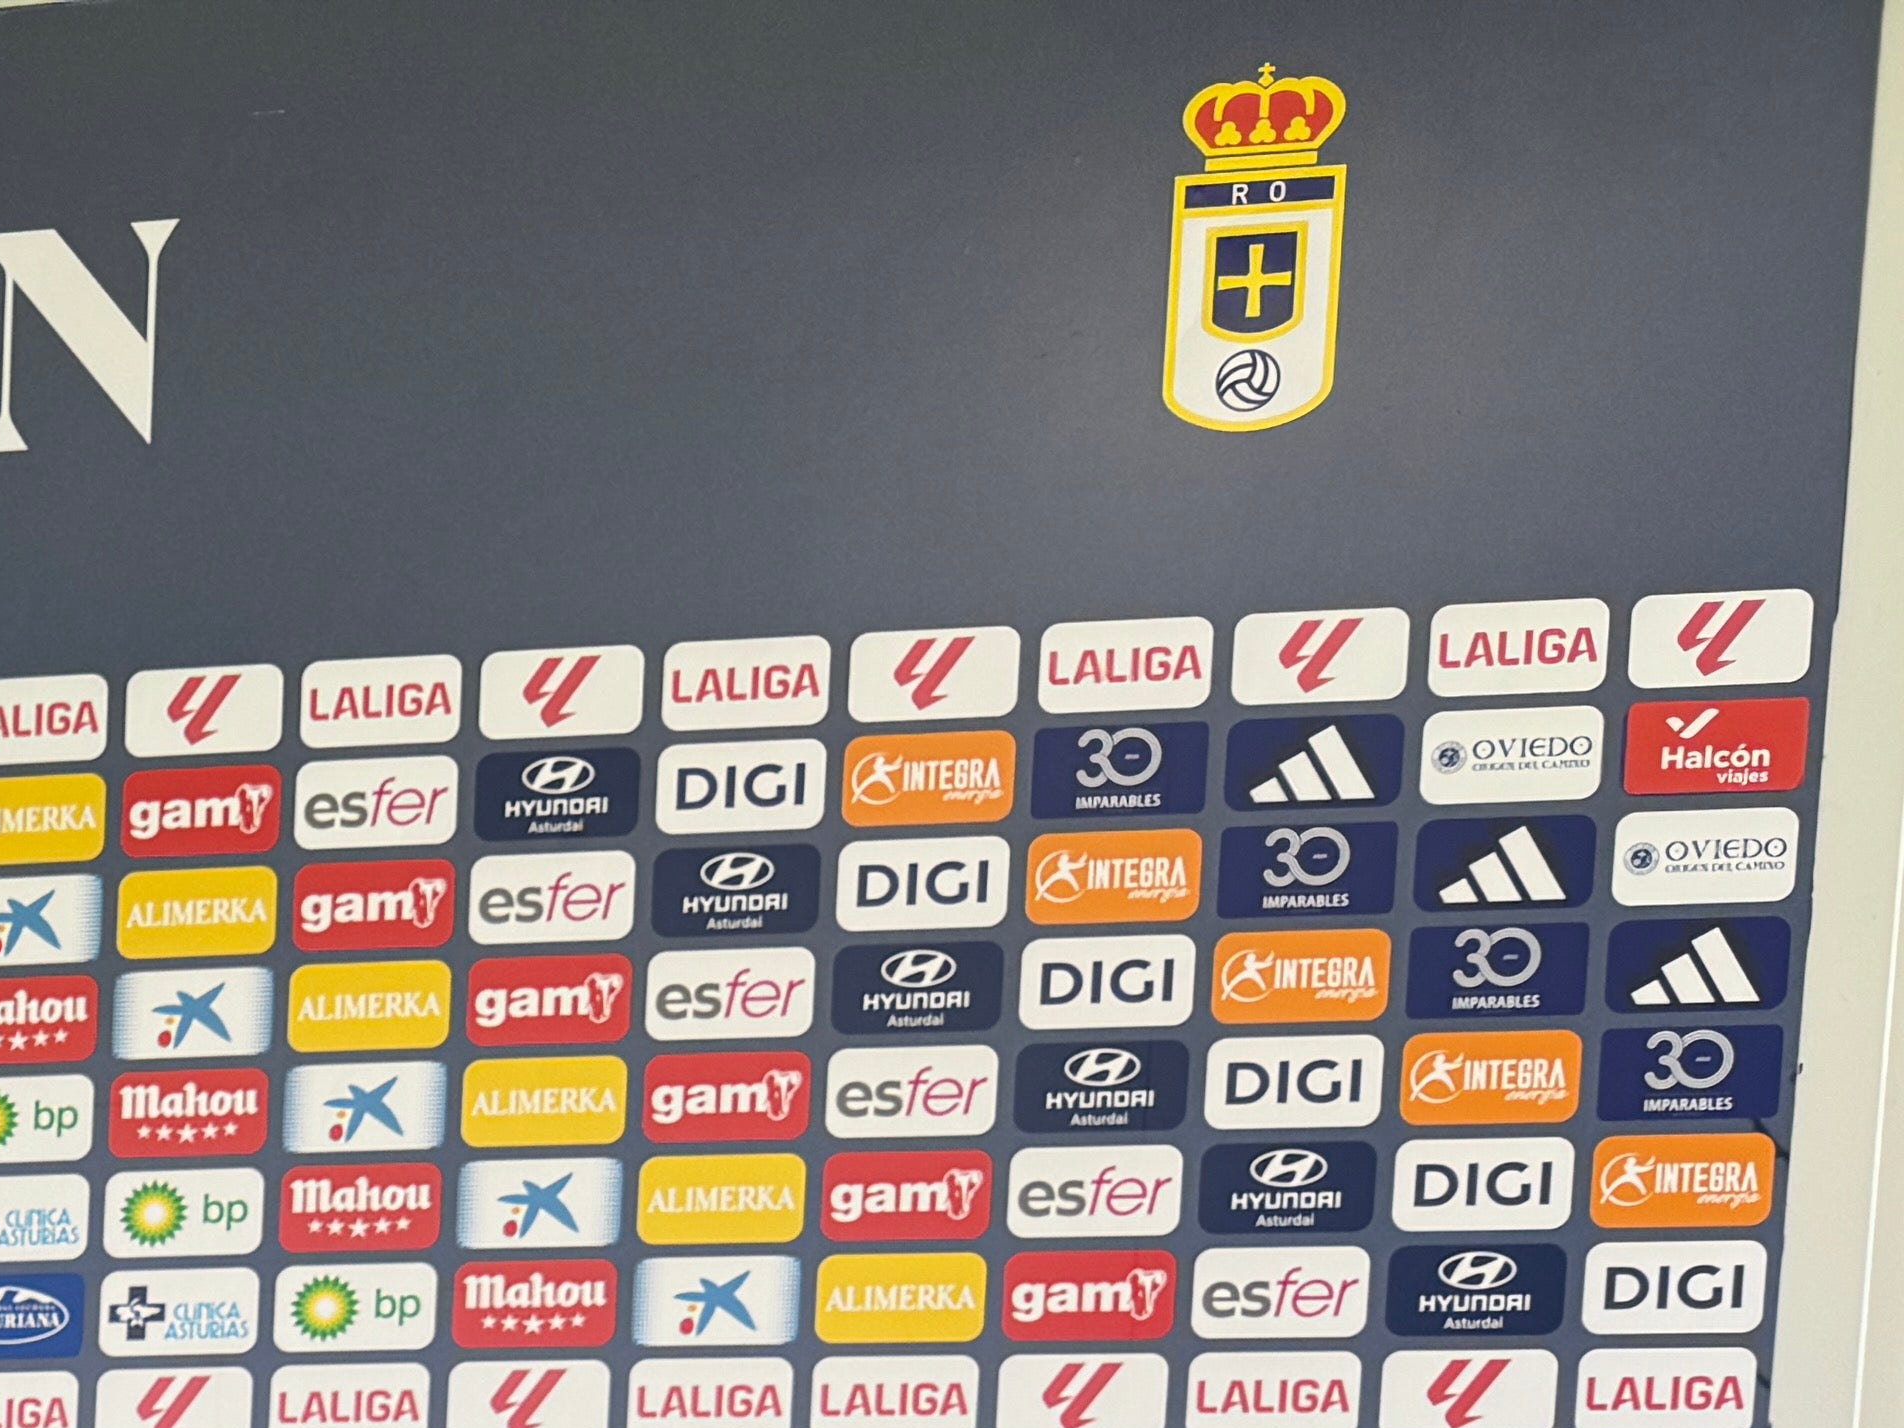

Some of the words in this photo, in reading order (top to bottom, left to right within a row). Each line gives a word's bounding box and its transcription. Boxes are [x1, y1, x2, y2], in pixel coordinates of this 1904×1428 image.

[1471, 735, 1593, 760] OVIEDO
[675, 762, 806, 810] DIGI
[902, 757, 1002, 793] INTEGRA
[304, 774, 449, 830] esfer
[478, 869, 626, 925] esfer
[655, 966, 805, 1021] esfer
[1463, 1057, 1568, 1092] INTEGRA
[33, 1099, 79, 1137] bp
[1045, 1090, 1156, 1110] HYUNDAI
[288, 1175, 432, 1214] Mahou
[647, 1182, 797, 1214] ALIMERKA
[1418, 1293, 1533, 1313] HYUNDAI
[1603, 1264, 1746, 1310] DIGI
[1195, 1378, 1353, 1414] LALIGA
